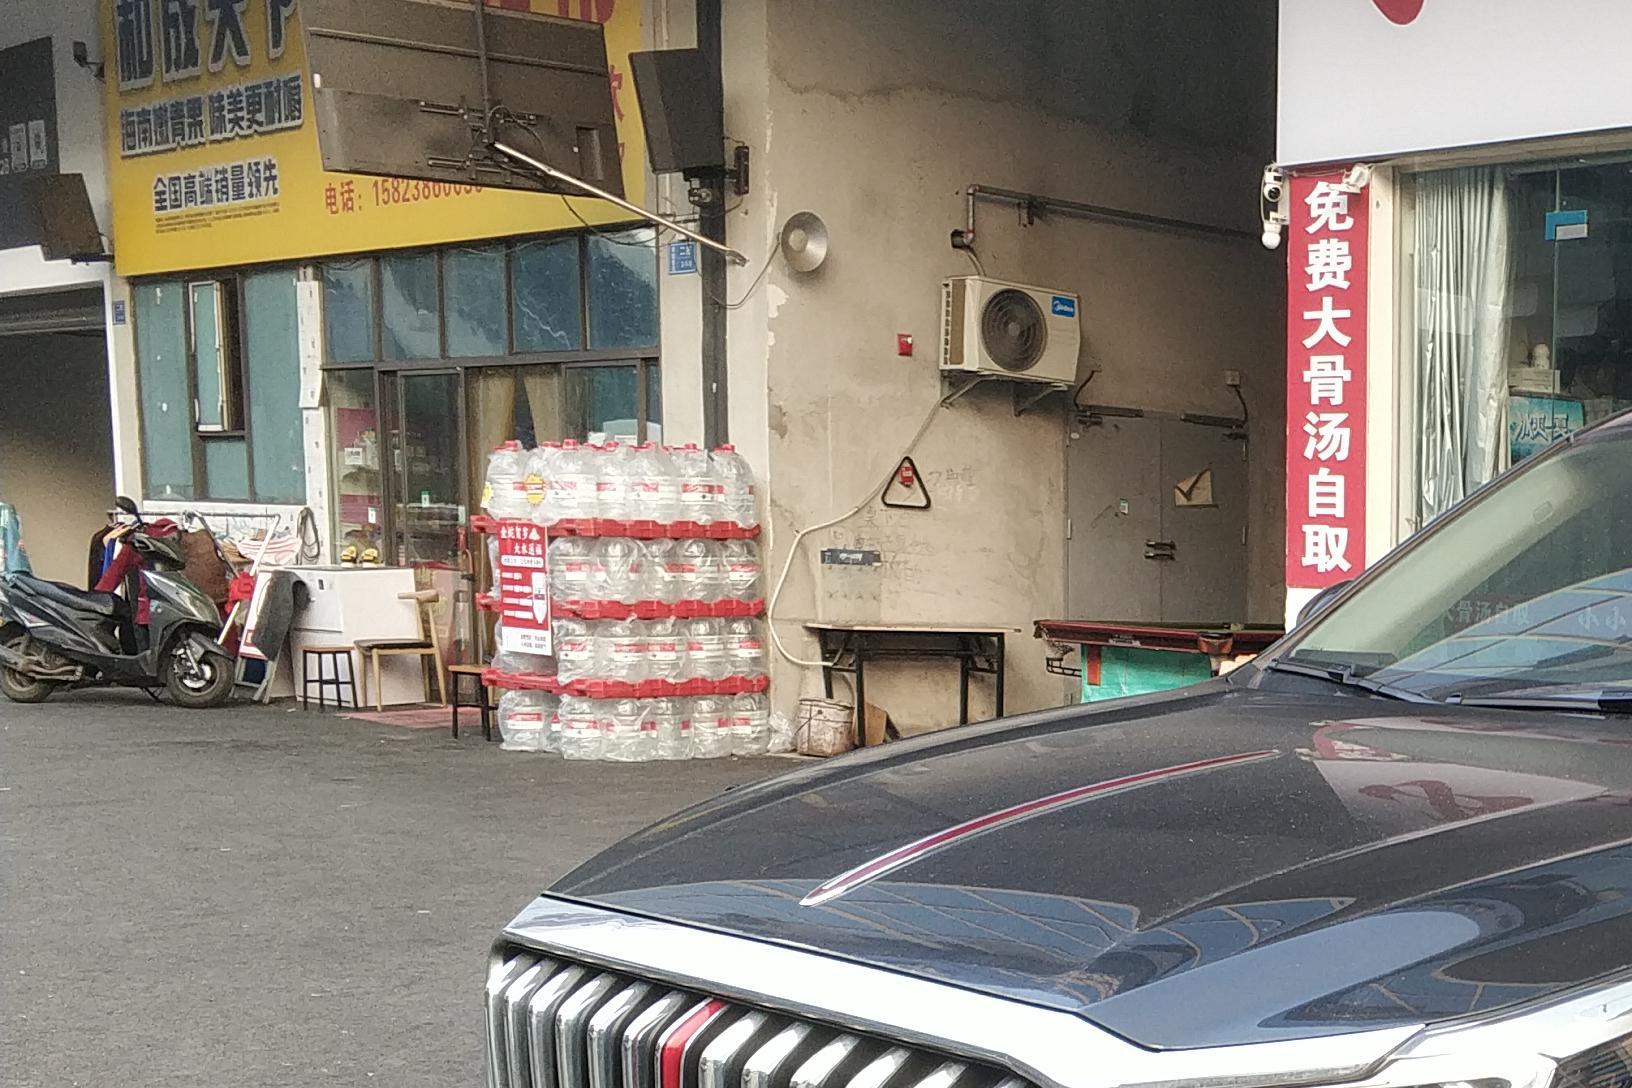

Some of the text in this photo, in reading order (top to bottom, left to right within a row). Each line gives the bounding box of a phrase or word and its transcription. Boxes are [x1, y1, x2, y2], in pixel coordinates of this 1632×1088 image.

[153, 158, 279, 212] 全国高端销量领先
[1302, 181, 1354, 573] 免费大骨汤自取
